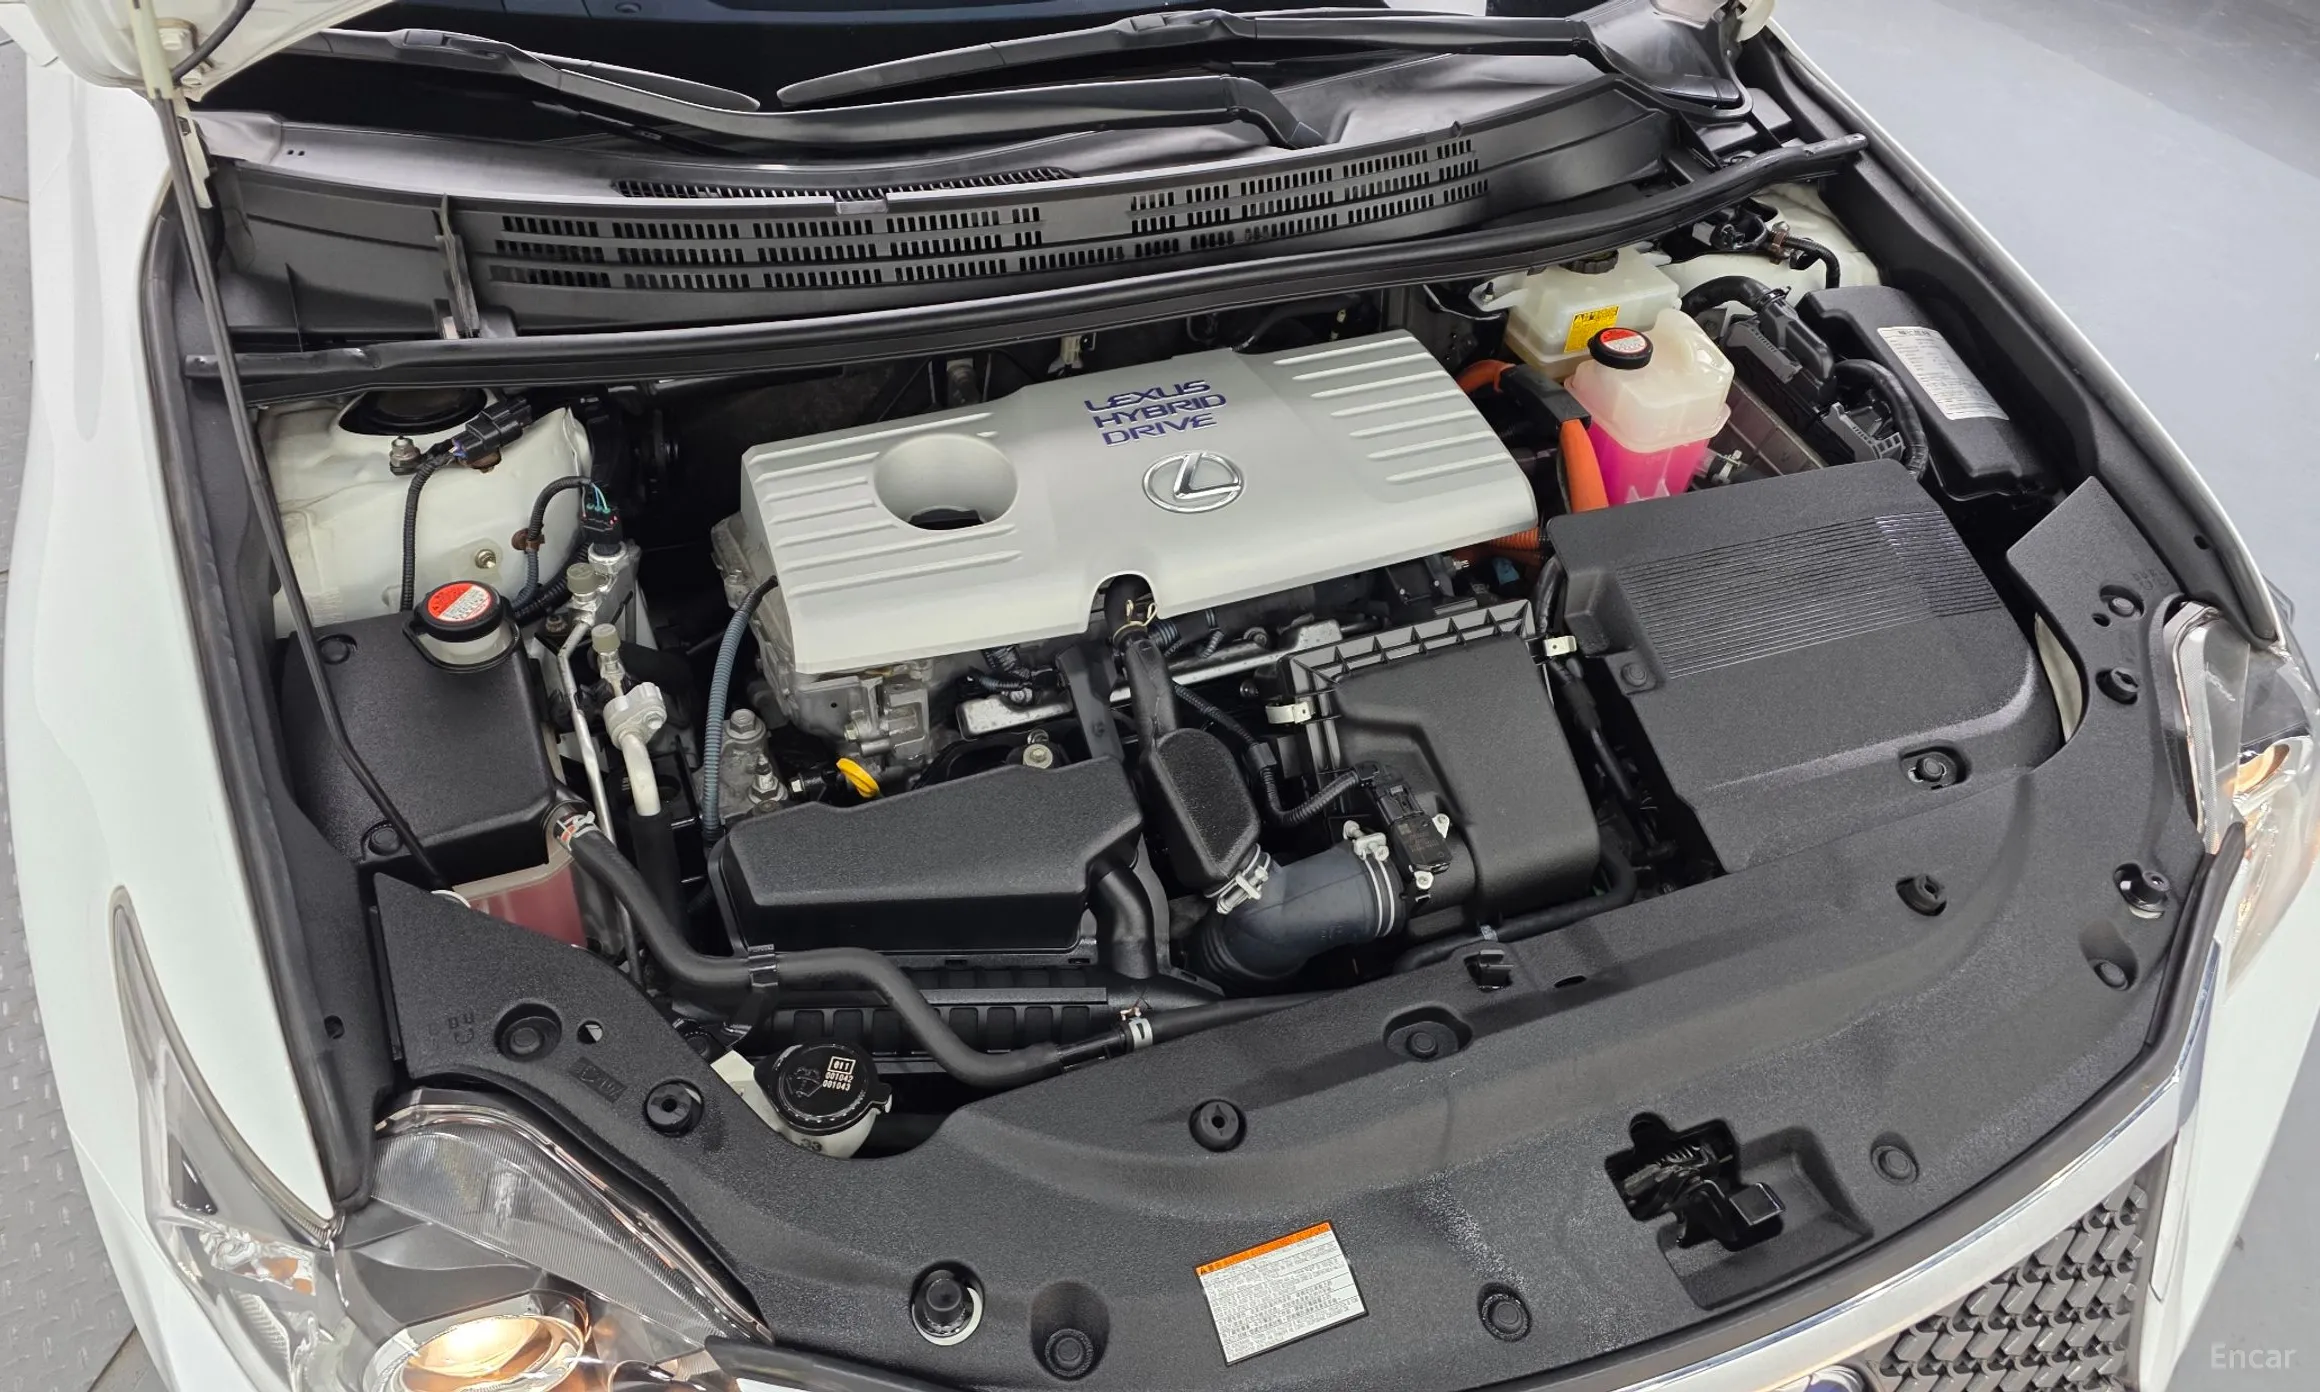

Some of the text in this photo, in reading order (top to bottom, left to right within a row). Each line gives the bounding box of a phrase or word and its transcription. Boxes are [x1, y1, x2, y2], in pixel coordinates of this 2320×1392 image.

[1084, 379, 1211, 412] LEXUS
[1092, 393, 1227, 429] HYBRID
[1101, 413, 1217, 446] DRIVE
[822, 1079, 851, 1091] 001043
